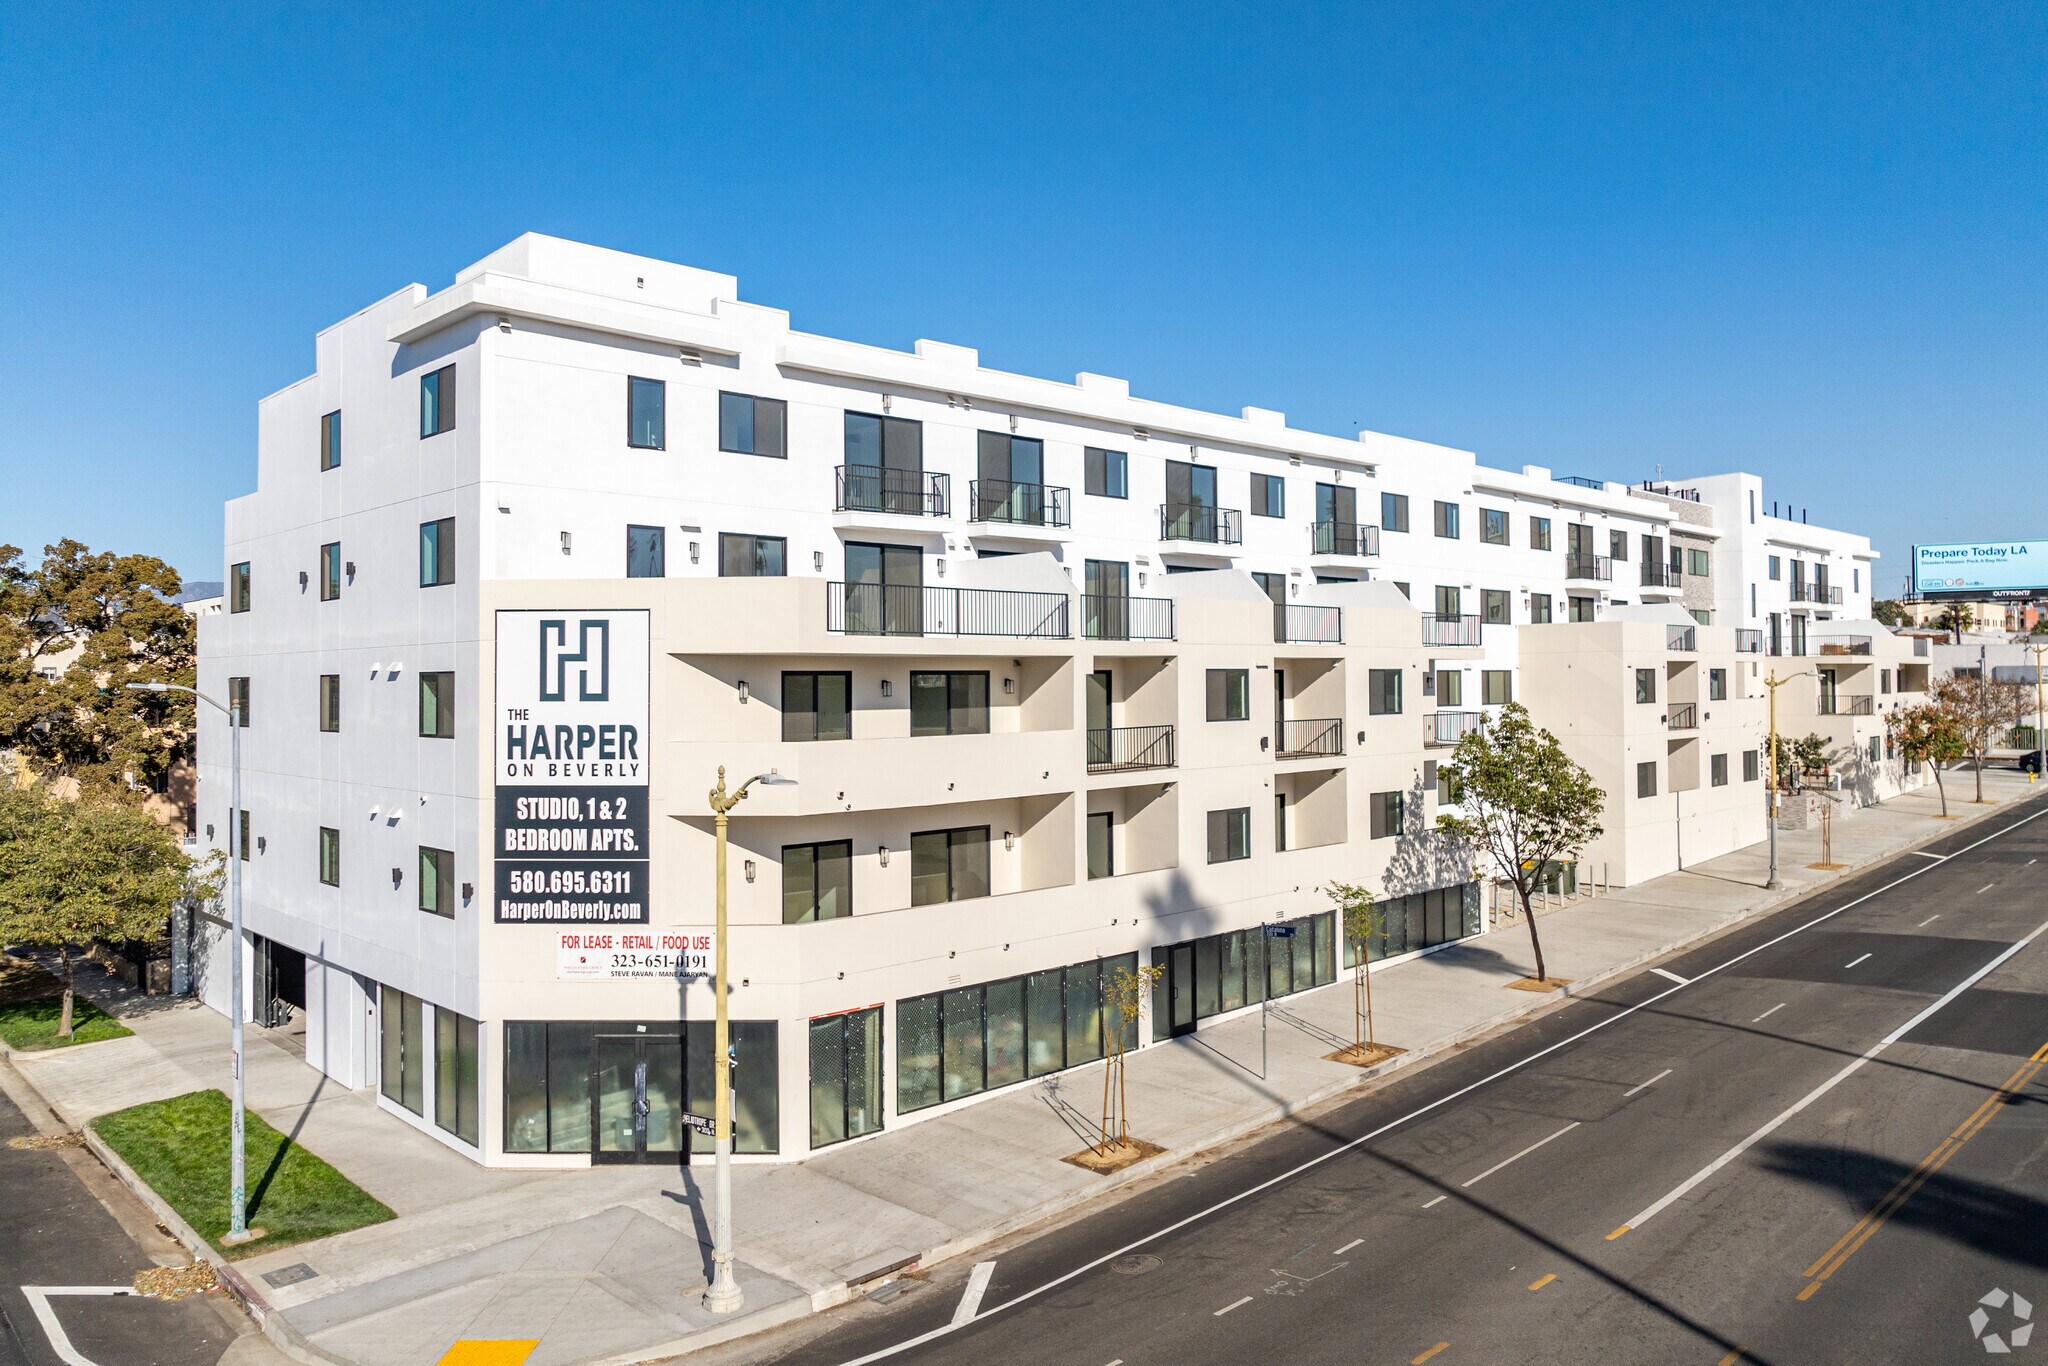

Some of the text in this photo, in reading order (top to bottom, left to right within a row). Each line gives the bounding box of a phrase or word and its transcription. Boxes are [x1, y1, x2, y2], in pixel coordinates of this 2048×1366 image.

[1921, 545, 2028, 559] Prepare Today LA
[507, 708, 529, 721] THE
[507, 724, 639, 760] HARPER
[507, 763, 639, 777] ON BEVERLY
[516, 797, 627, 822] STUDIO, 1 & 2
[505, 828, 639, 851] BEDROOM APTS.
[510, 870, 631, 894] 580.695.6311
[501, 899, 641, 921] HarperOnBeverly.com
[561, 935, 580, 949] FOR
[583, 935, 613, 949] LEASE
[622, 935, 654, 949] RETAIL
[662, 935, 689, 950] FOOD
[692, 936, 710, 950] USE
[611, 954, 707, 969] 323-651-0191
[610, 970, 630, 978] STEVE
[631, 970, 654, 978] RAVAN
[658, 970, 678, 978] MANE
